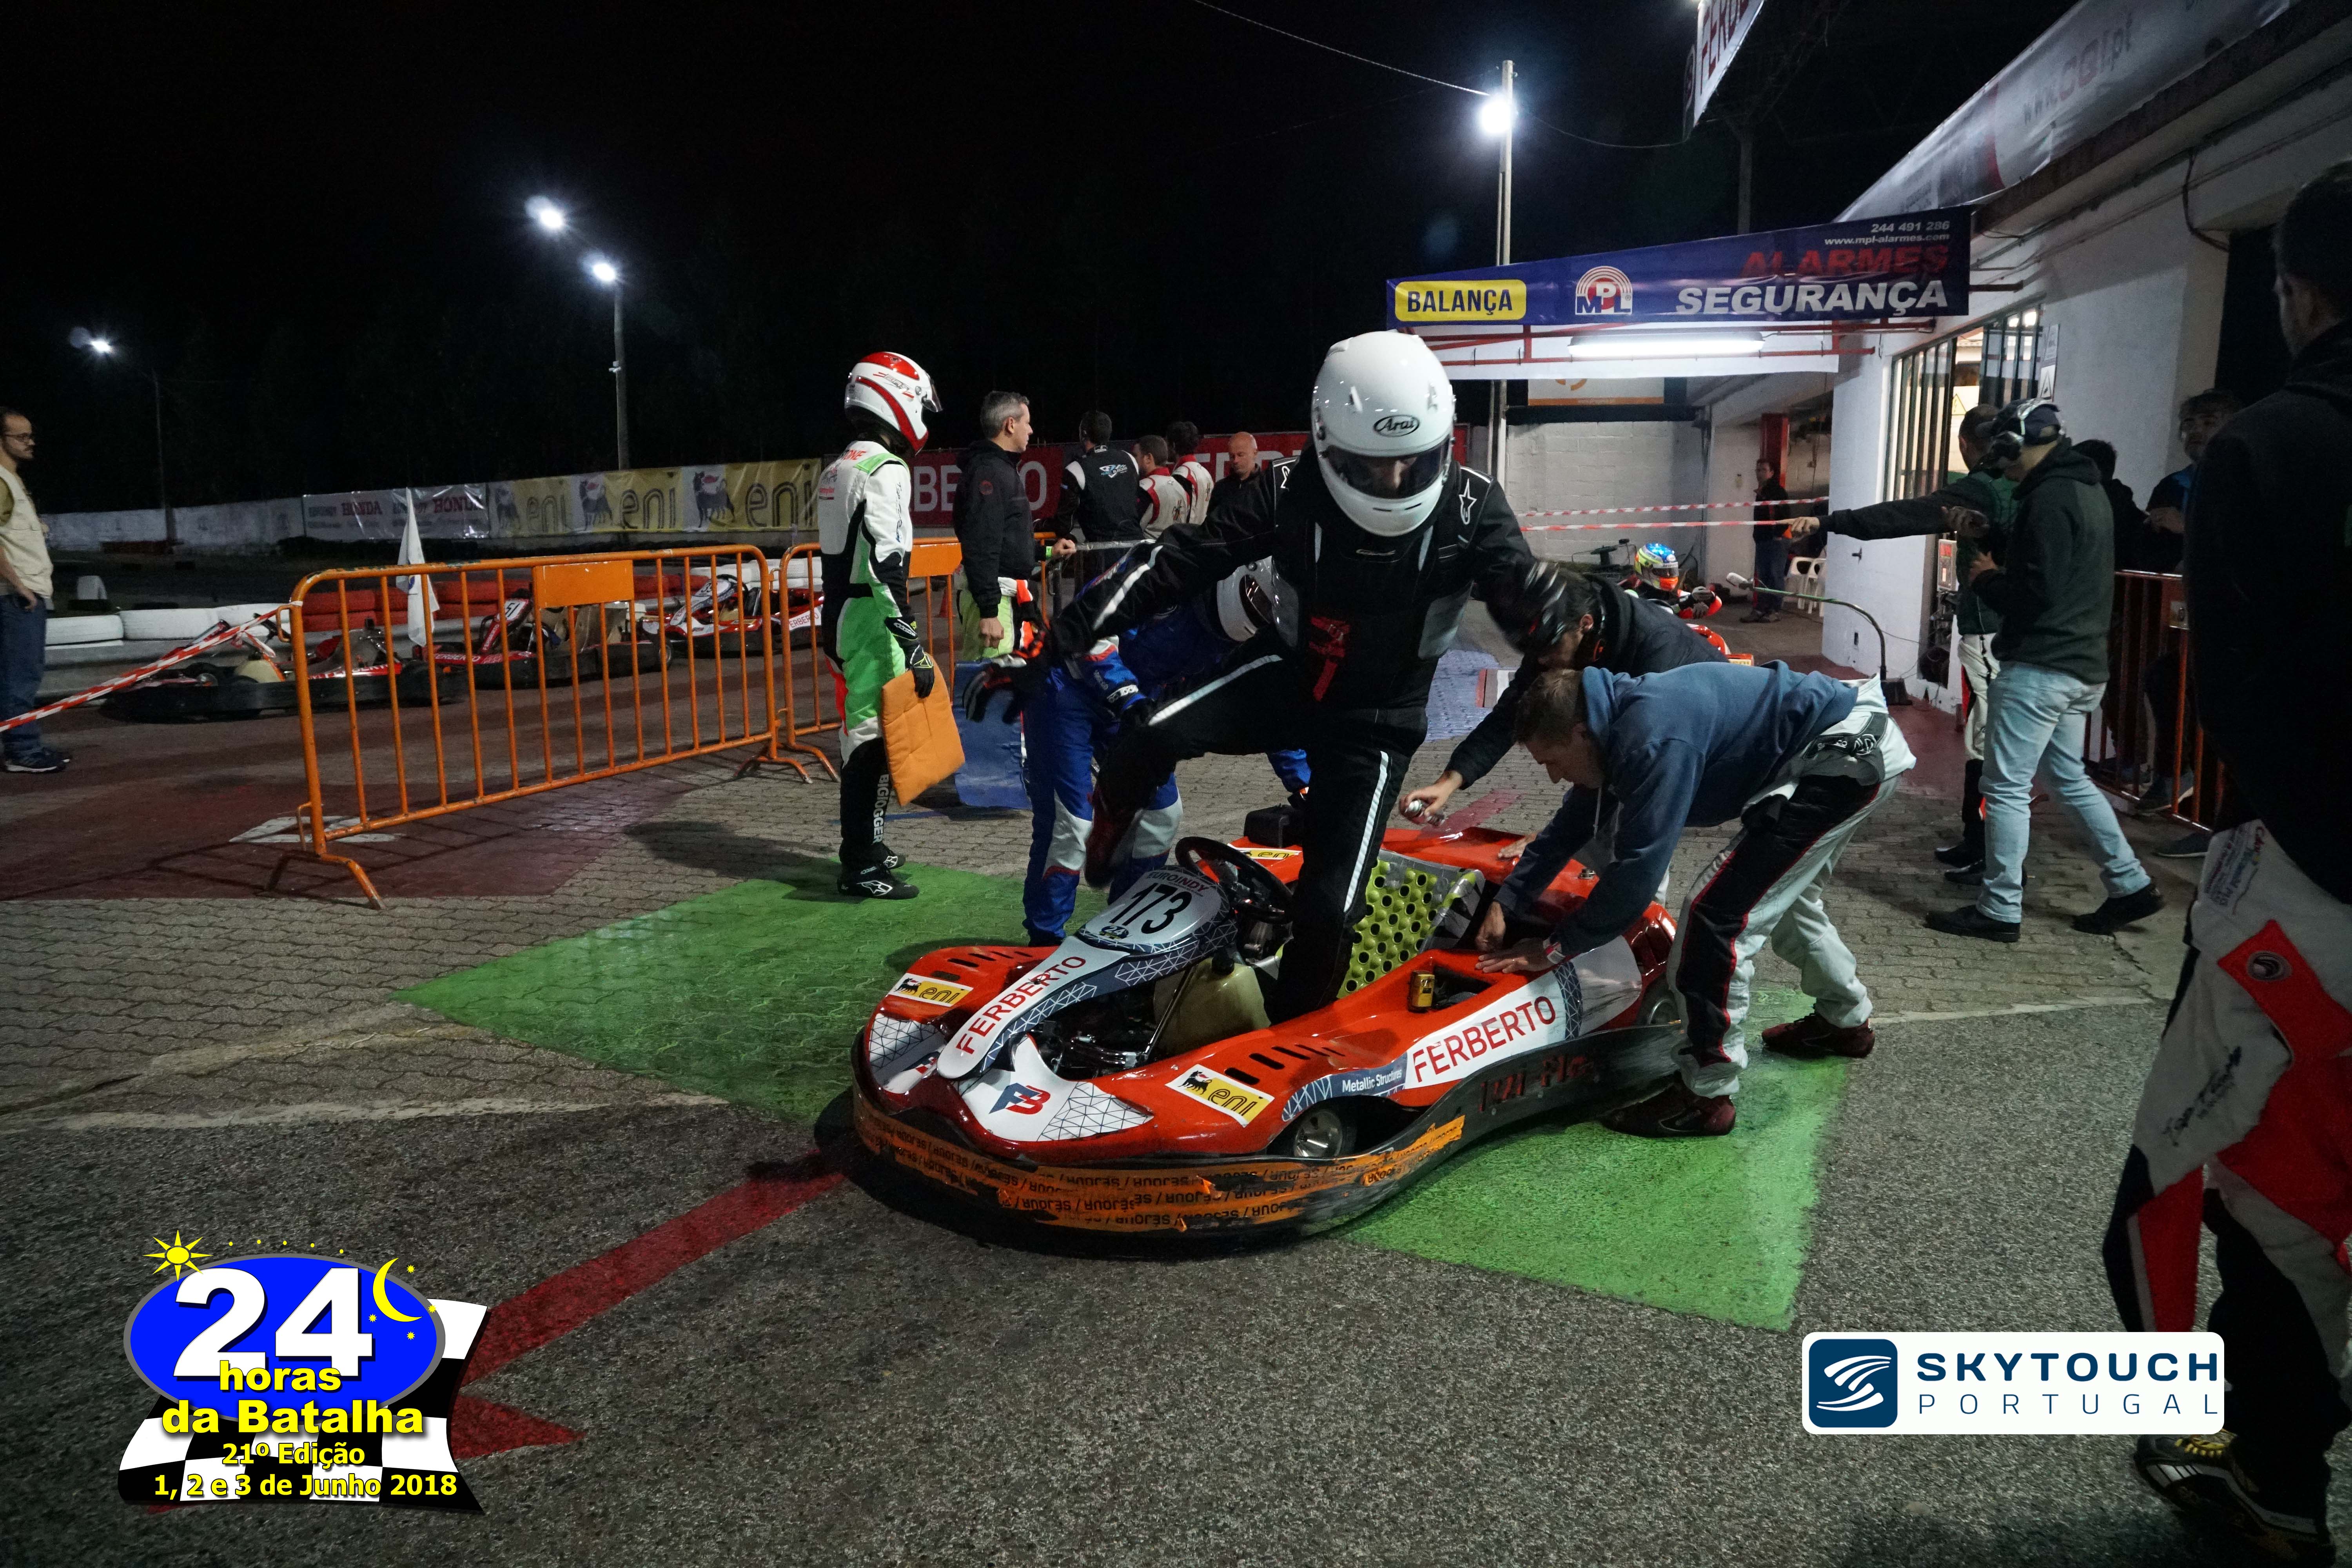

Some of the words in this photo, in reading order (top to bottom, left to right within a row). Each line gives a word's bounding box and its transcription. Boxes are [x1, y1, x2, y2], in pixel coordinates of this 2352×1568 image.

[1825, 234, 1950, 245] www.mpl-alarmes.com
[1871, 223, 1894, 233] 244
[1899, 221, 1921, 232] 491
[1927, 221, 1950, 231] 286
[1740, 245, 1948, 277] ALARMES
[1408, 289, 1513, 316] BALANÇA
[1675, 280, 1948, 316] SEGURANÇA
[1381, 418, 1415, 430] Arai
[621, 472, 676, 529] eni
[746, 463, 812, 528] eni
[1109, 882, 1192, 934] 173
[920, 987, 965, 1004] eni
[956, 956, 1086, 1054] FERBERTO
[1413, 996, 1556, 1082] FERBERTO
[1342, 1076, 1375, 1092] Metallic
[1376, 1068, 1402, 1087] Structures
[1207, 1088, 1263, 1116] eni
